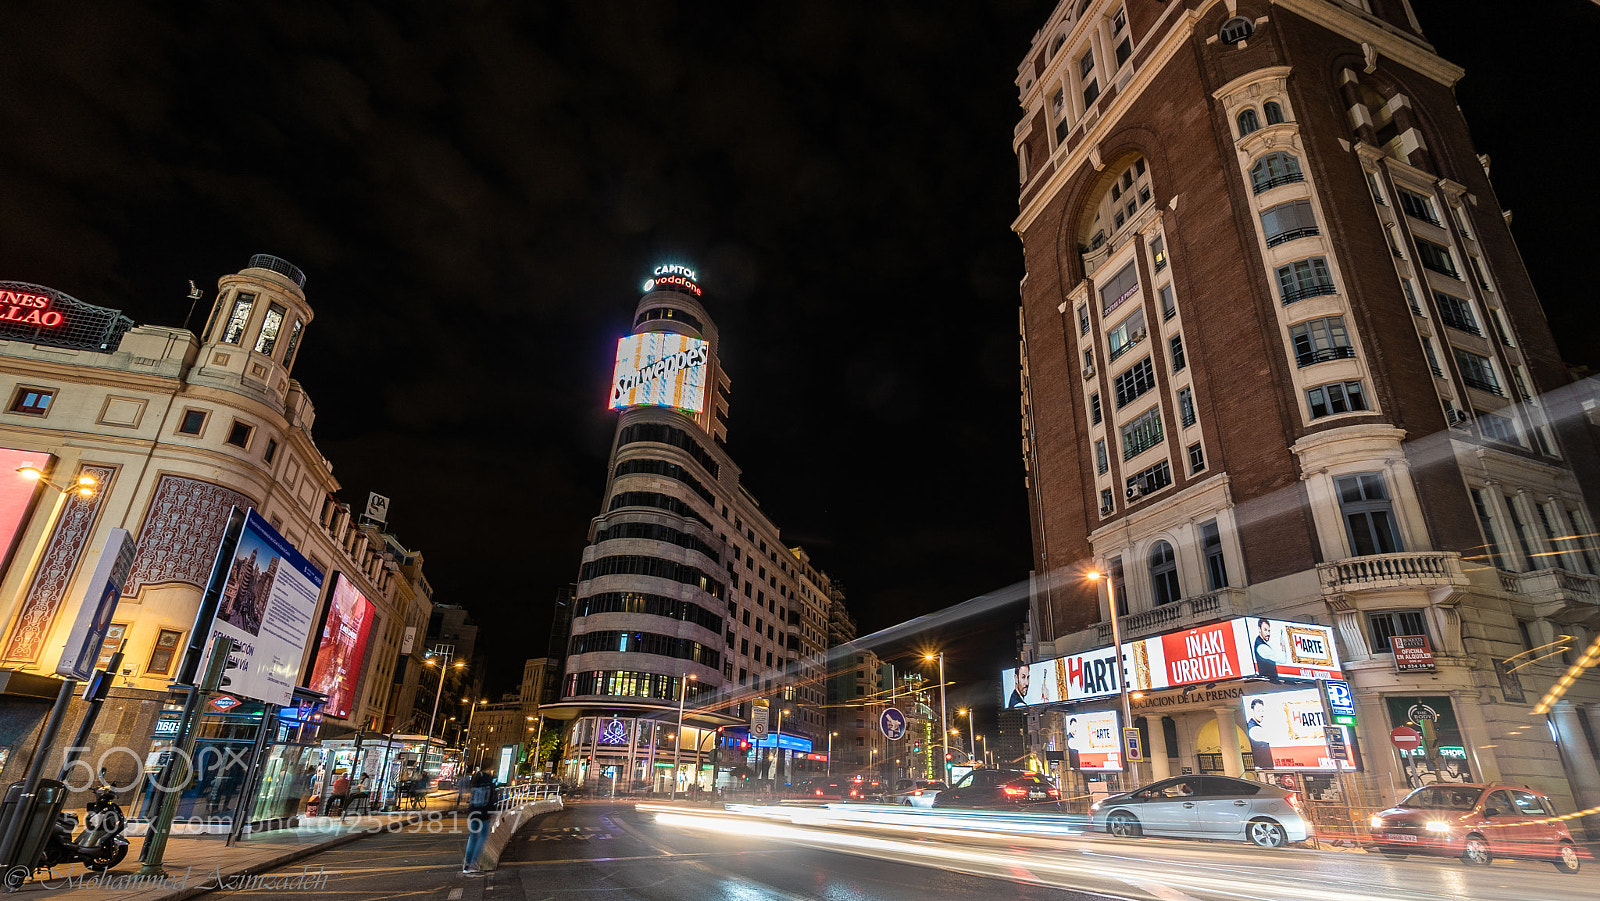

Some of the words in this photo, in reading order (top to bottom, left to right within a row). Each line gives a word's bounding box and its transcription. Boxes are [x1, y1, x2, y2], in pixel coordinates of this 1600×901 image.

[654, 264, 697, 281] CAPITOL
[654, 275, 702, 297] vodafone
[613, 344, 708, 400] Schweppes
[1185, 630, 1226, 659] IÑAKI
[1294, 634, 1324, 654] HARTE
[1172, 652, 1233, 684] URRUTIA
[1129, 695, 1175, 710] SOCIACION
[1191, 691, 1205, 704] LA
[1205, 687, 1245, 701] PRENSA
[1440, 748, 1464, 756] SHOP
